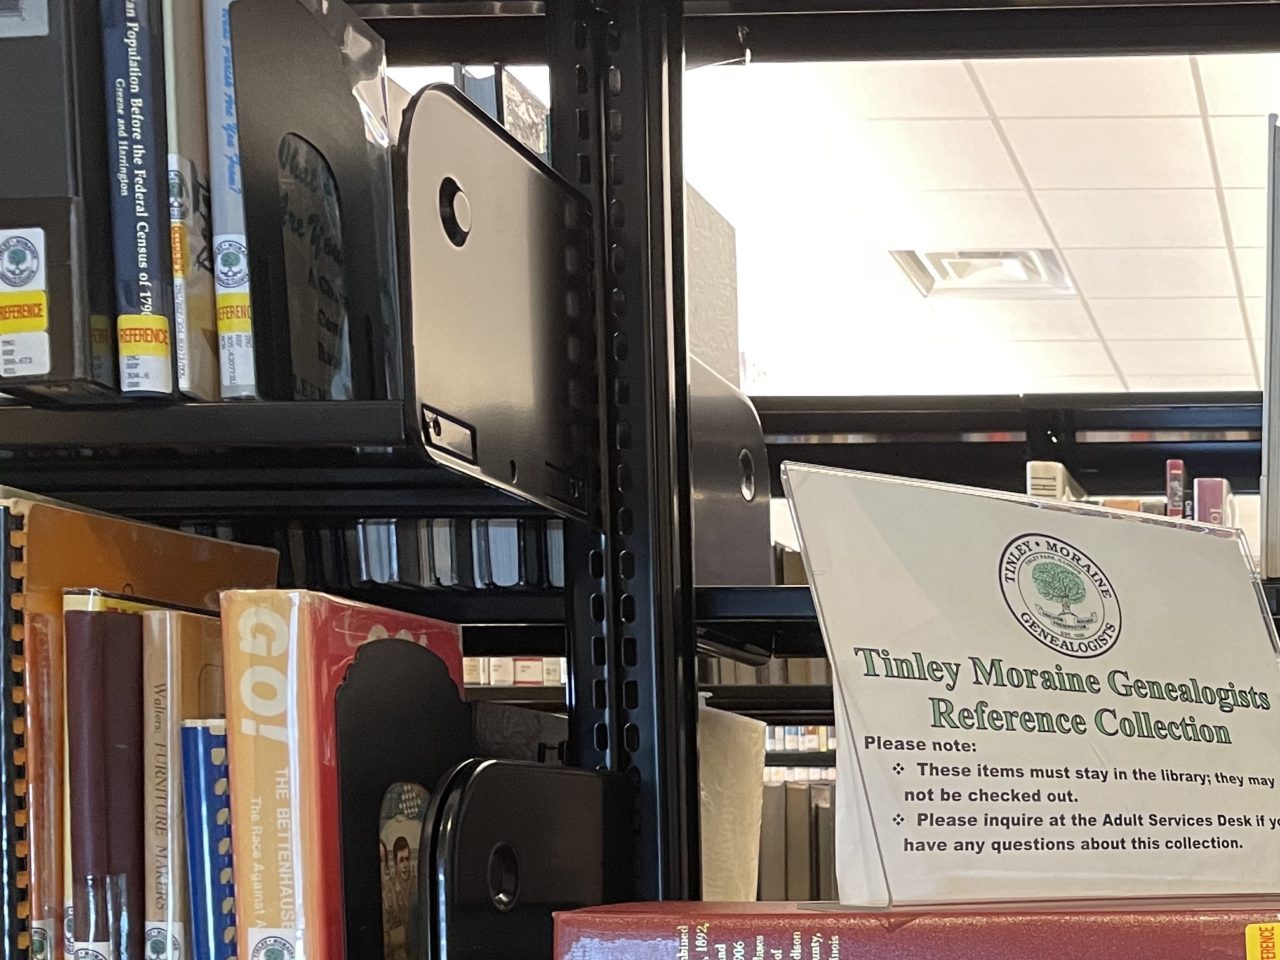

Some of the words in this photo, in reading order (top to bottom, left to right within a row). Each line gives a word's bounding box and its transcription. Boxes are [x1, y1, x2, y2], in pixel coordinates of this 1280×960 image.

[125, 21, 140, 93] Population
[115, 78, 125, 114] Greene
[118, 119, 126, 134] and
[130, 98, 142, 140] Before
[118, 136, 128, 197] Harrington
[133, 144, 142, 161] the
[134, 165, 148, 217] Federal
[135, 220, 150, 269] Census
[138, 273, 150, 287] of
[1005, 541, 1032, 583] TINLEY
[1046, 541, 1112, 599] MORAINE
[1021, 612, 1115, 653] GENEALOGISTS
[238, 606, 289, 744] GO!
[854, 647, 960, 690] Tinley
[969, 657, 1099, 694] Moraine
[1107, 670, 1270, 712] Genealogists
[929, 697, 1087, 735] Reference
[1094, 708, 1232, 744] Collection
[865, 736, 926, 750] Please
[933, 740, 977, 752] note:
[917, 762, 971, 777] These
[977, 764, 1024, 778] items
[1030, 767, 1070, 779] must
[1075, 767, 1108, 782] stay
[1114, 768, 1127, 780] in
[1132, 769, 1156, 781] the
[1161, 770, 1211, 785] library;
[1215, 773, 1243, 787] they
[1249, 777, 1275, 788] may
[904, 789, 934, 801] not
[940, 788, 962, 801] be
[968, 789, 1041, 802] checked
[1047, 790, 1078, 802] out.
[917, 813, 977, 827] Please
[984, 813, 1043, 829] inquire
[1049, 814, 1066, 827] at
[1071, 813, 1096, 827] the
[1102, 813, 1144, 827] Adult
[1149, 814, 1213, 827] Services
[1217, 814, 1252, 827] Desk
[1256, 815, 1265, 827] if
[903, 838, 947, 852] have
[953, 839, 985, 854] any
[991, 838, 1075, 855] questions
[1080, 837, 1126, 850] about
[1131, 837, 1160, 850] this
[1164, 837, 1243, 850] collection.
[696, 923, 709, 952] 1892,
[771, 949, 782, 960] of
